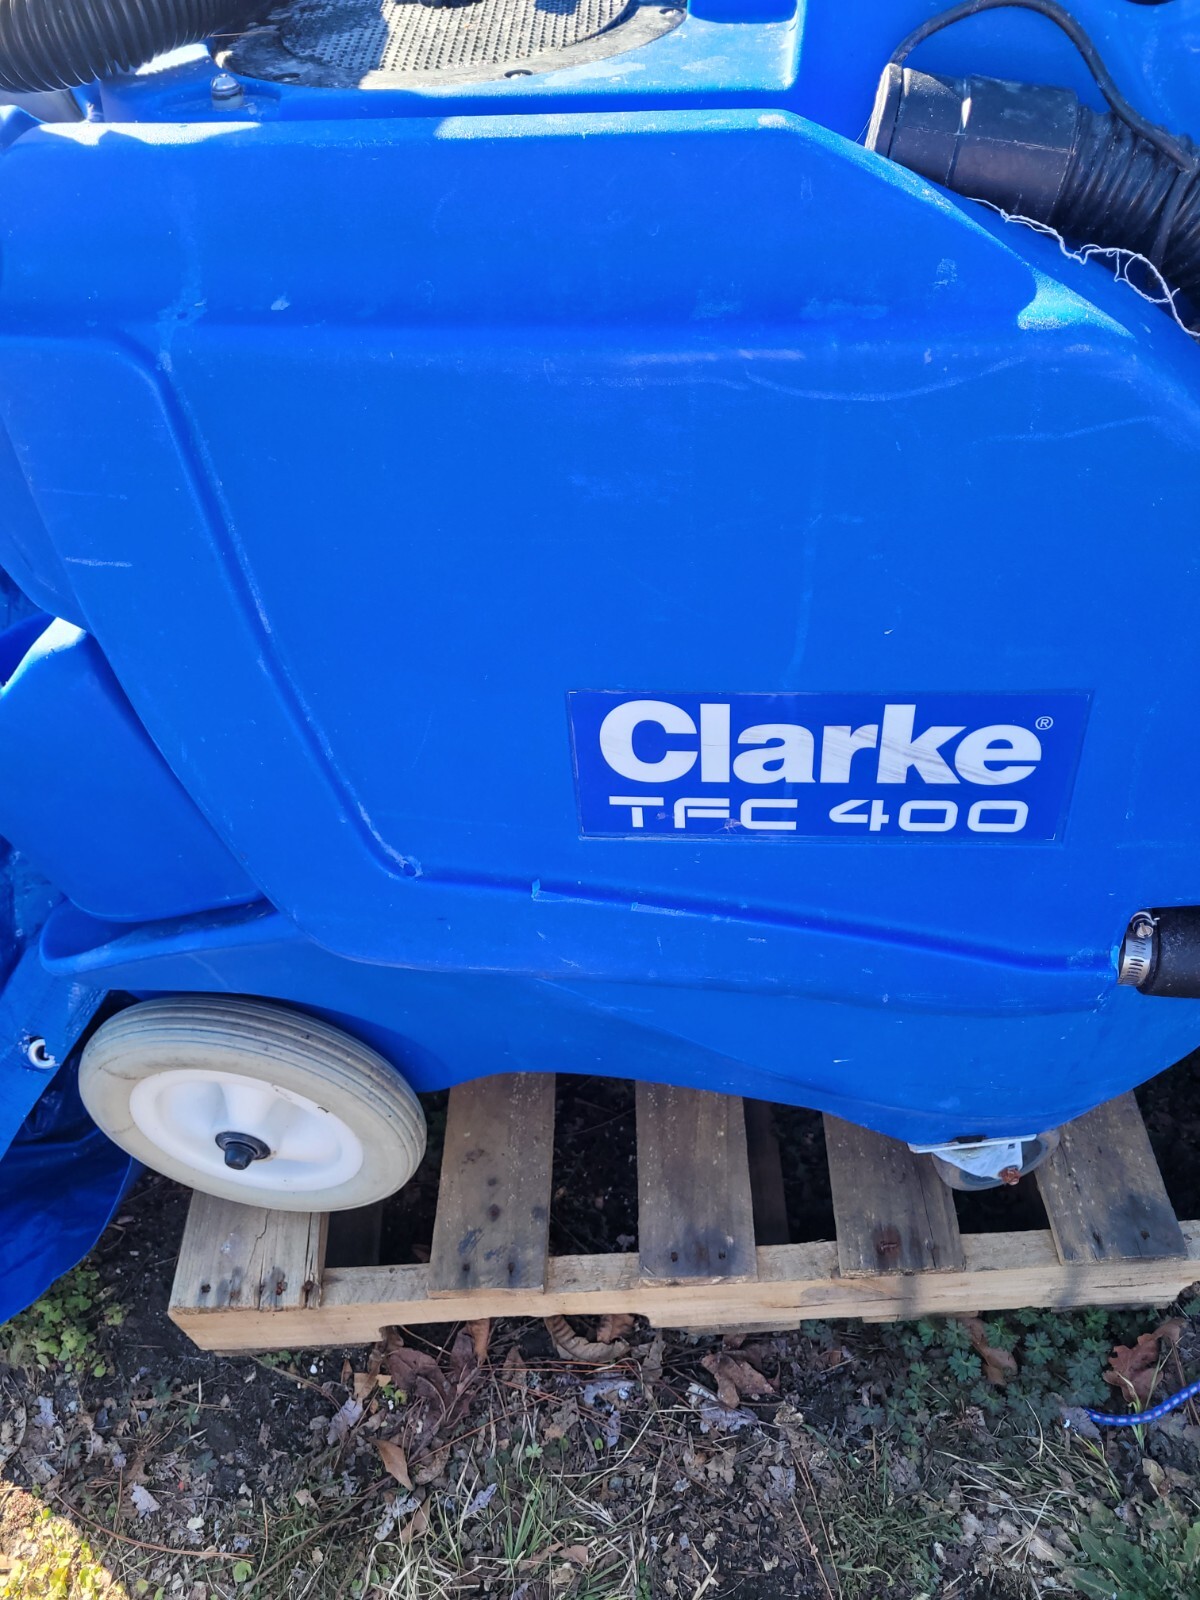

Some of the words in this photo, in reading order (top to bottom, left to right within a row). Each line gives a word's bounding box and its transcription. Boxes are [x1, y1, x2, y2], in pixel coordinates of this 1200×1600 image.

[599, 699, 1042, 785] Clarke
[608, 796, 798, 830] TFC
[829, 799, 1029, 832] 400
